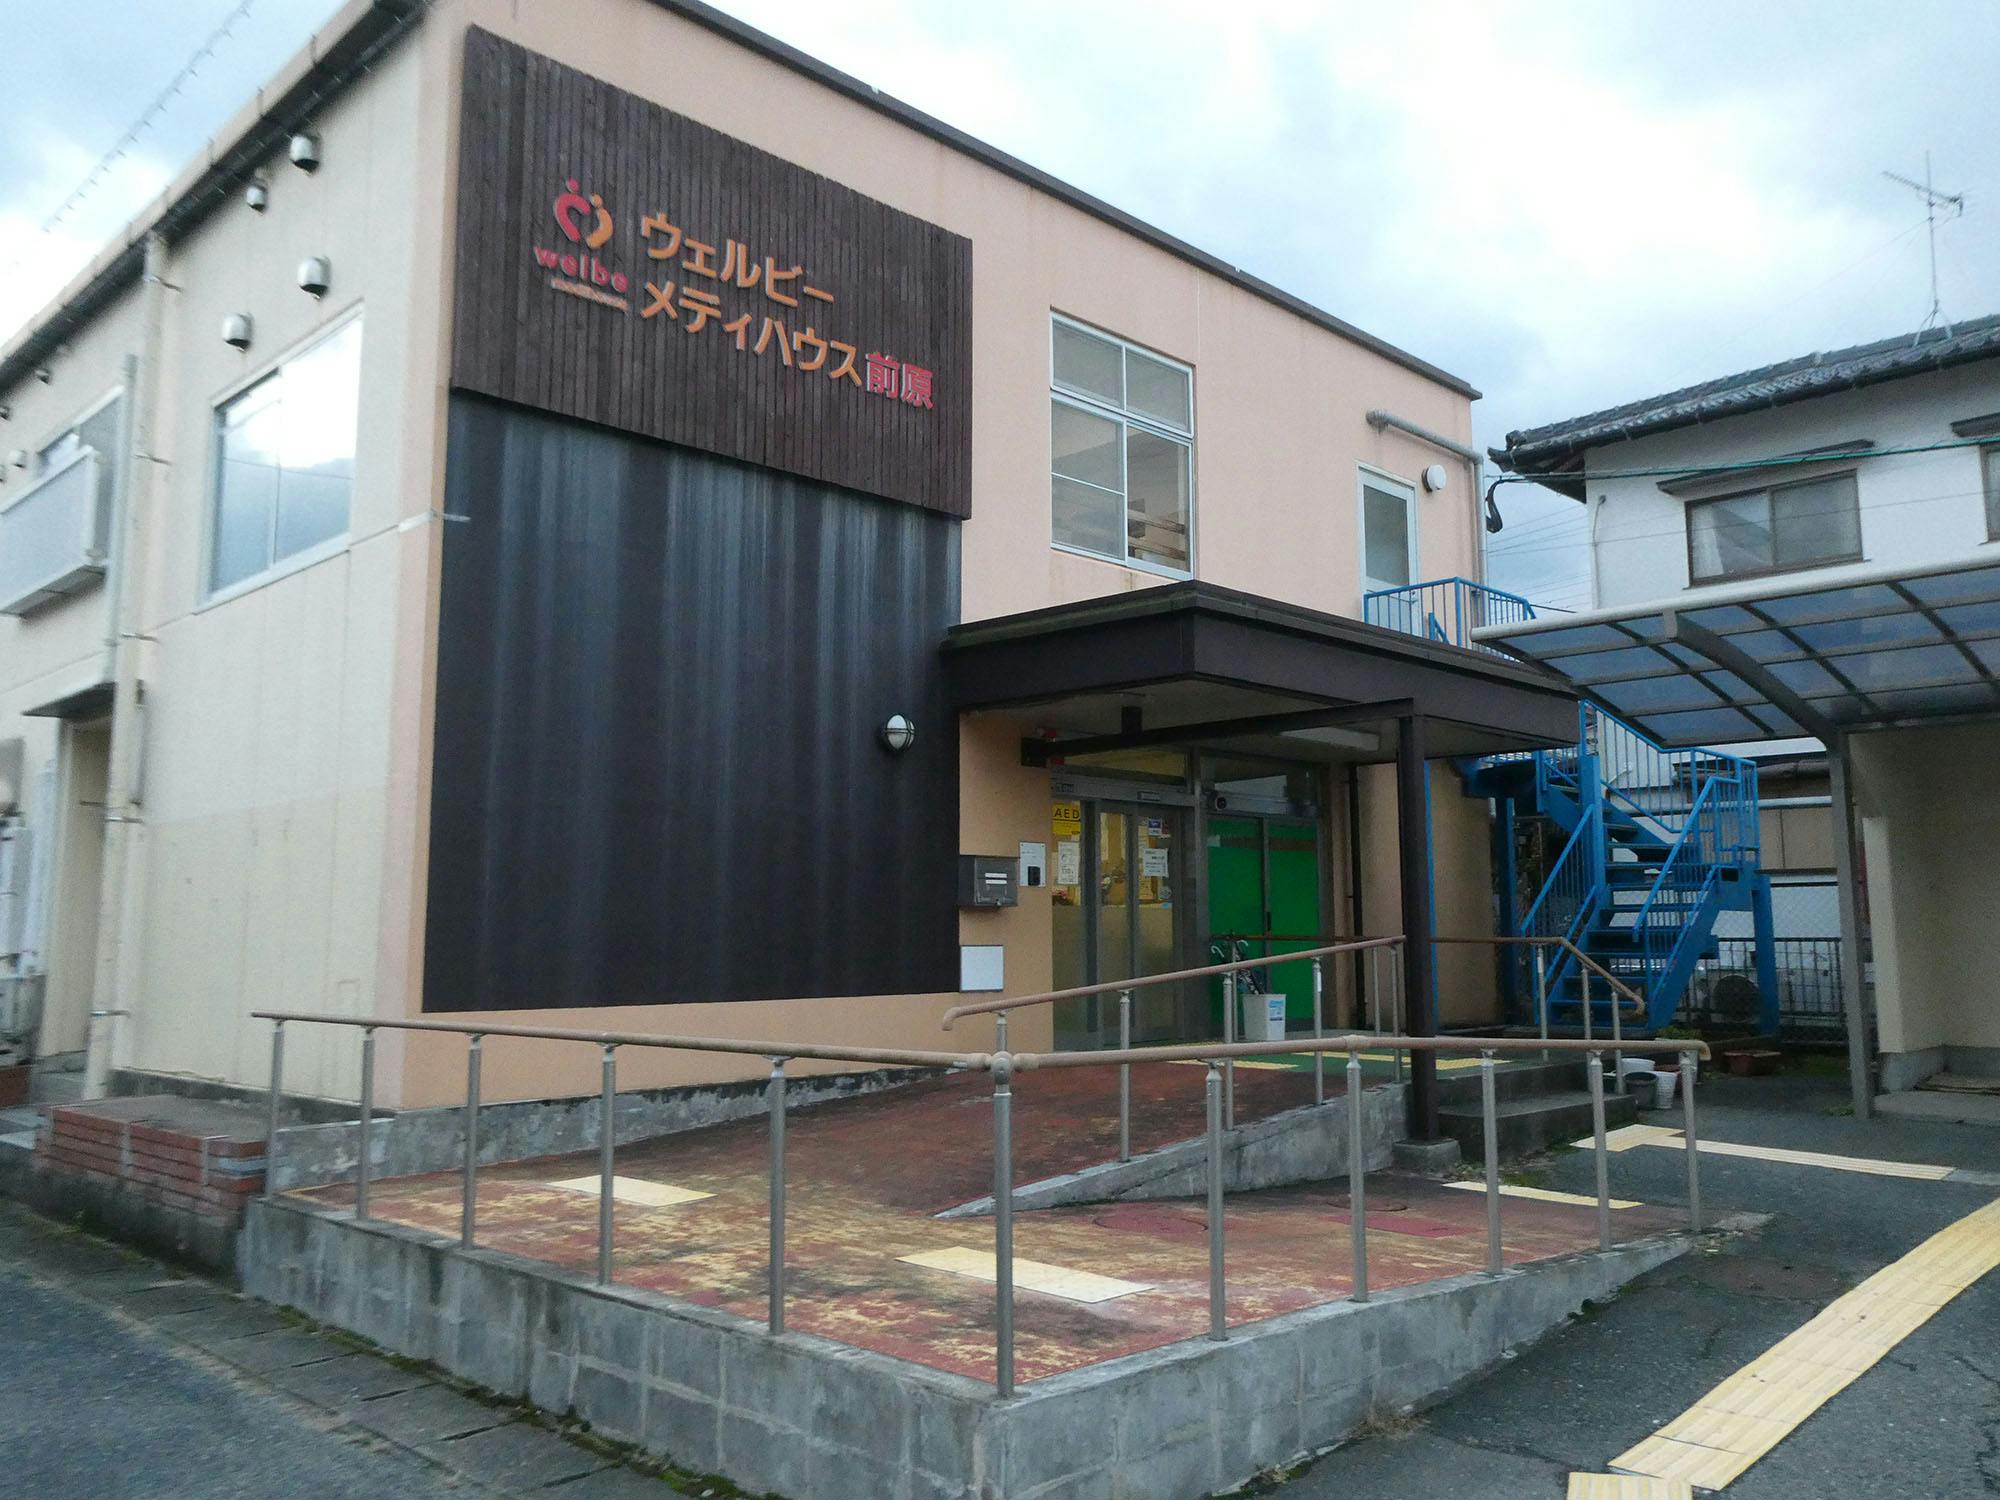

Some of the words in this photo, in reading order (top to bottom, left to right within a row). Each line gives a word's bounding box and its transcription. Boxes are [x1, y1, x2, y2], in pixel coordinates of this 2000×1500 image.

[533, 246, 629, 293] welbe
[641, 211, 834, 307] ウェルビー
[1054, 807, 1080, 819] AED
